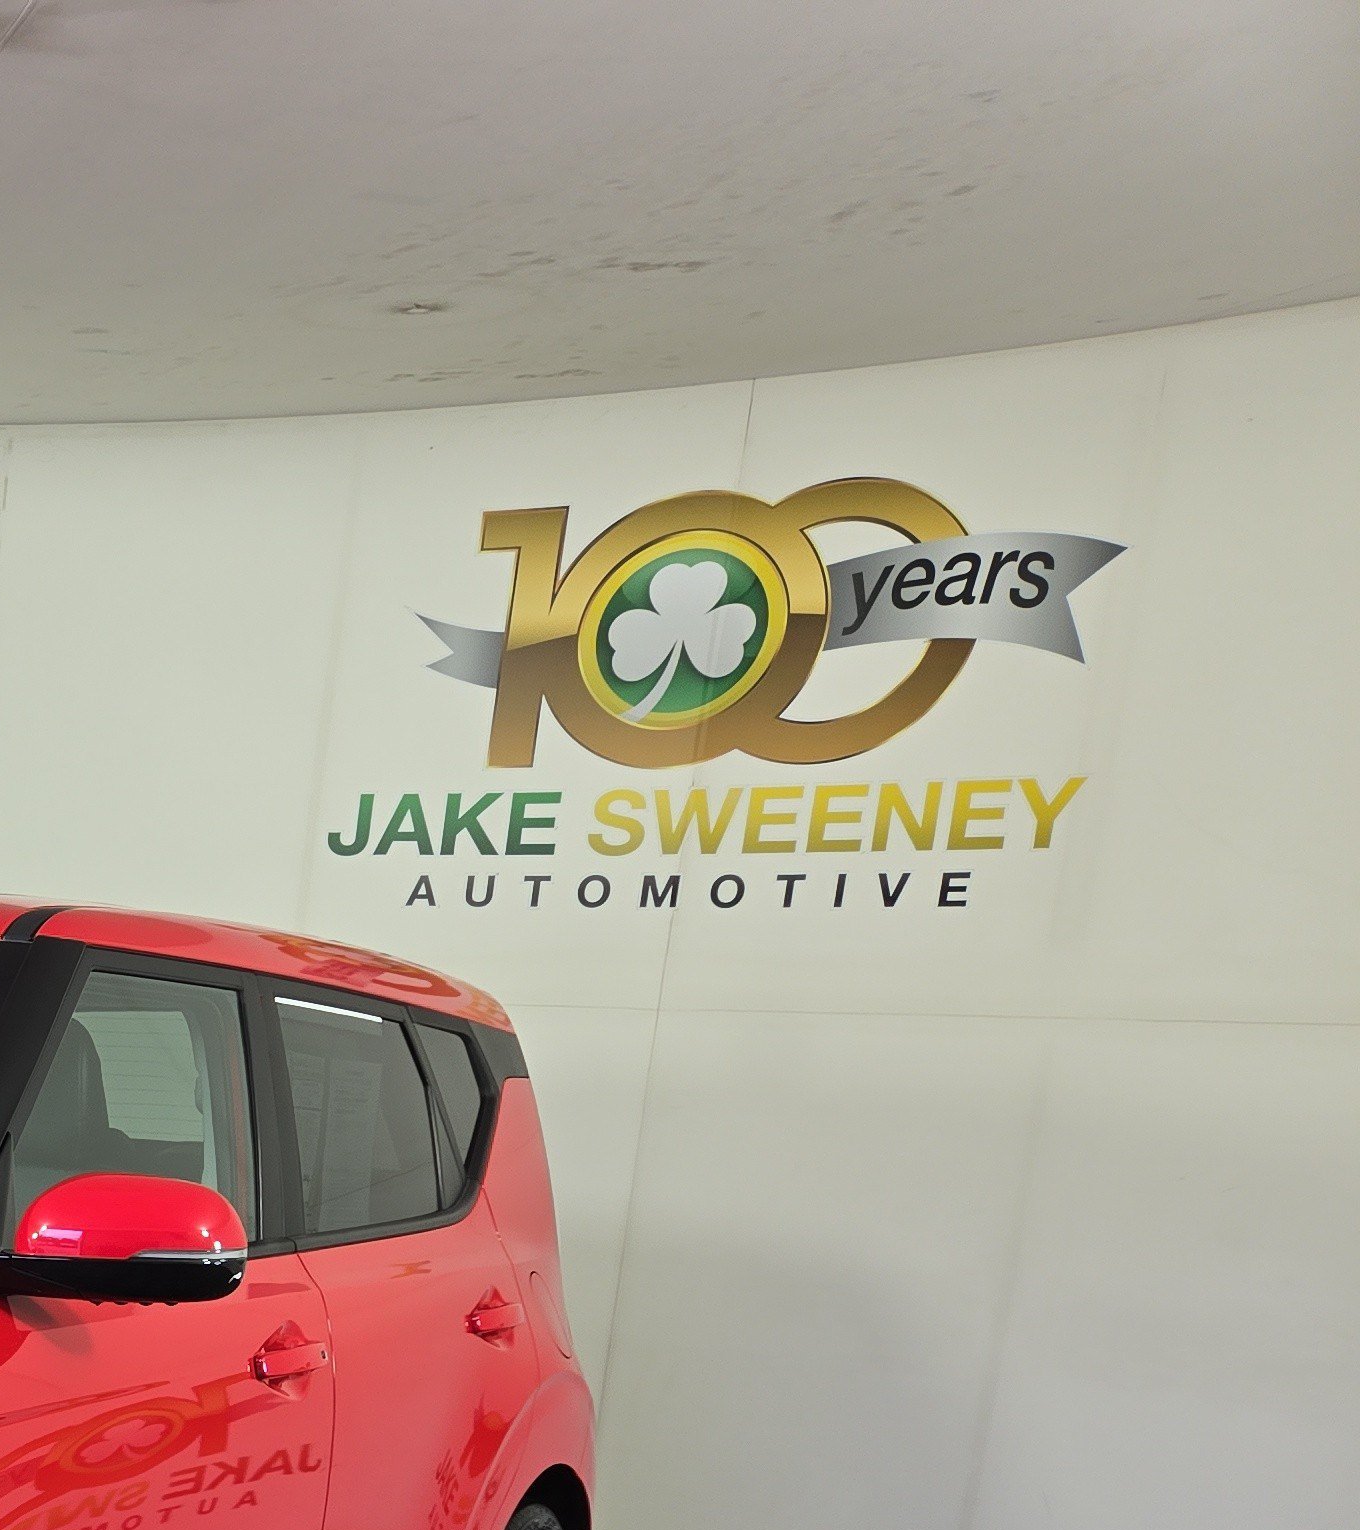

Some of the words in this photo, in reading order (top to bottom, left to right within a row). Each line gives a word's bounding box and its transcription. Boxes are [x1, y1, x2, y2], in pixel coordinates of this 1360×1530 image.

[479, 476, 978, 770] 100
[840, 547, 1056, 637] years
[326, 791, 563, 857] JAKE
[587, 776, 1088, 856] SWEENEY
[405, 872, 974, 910] AUTOMOTIVE
